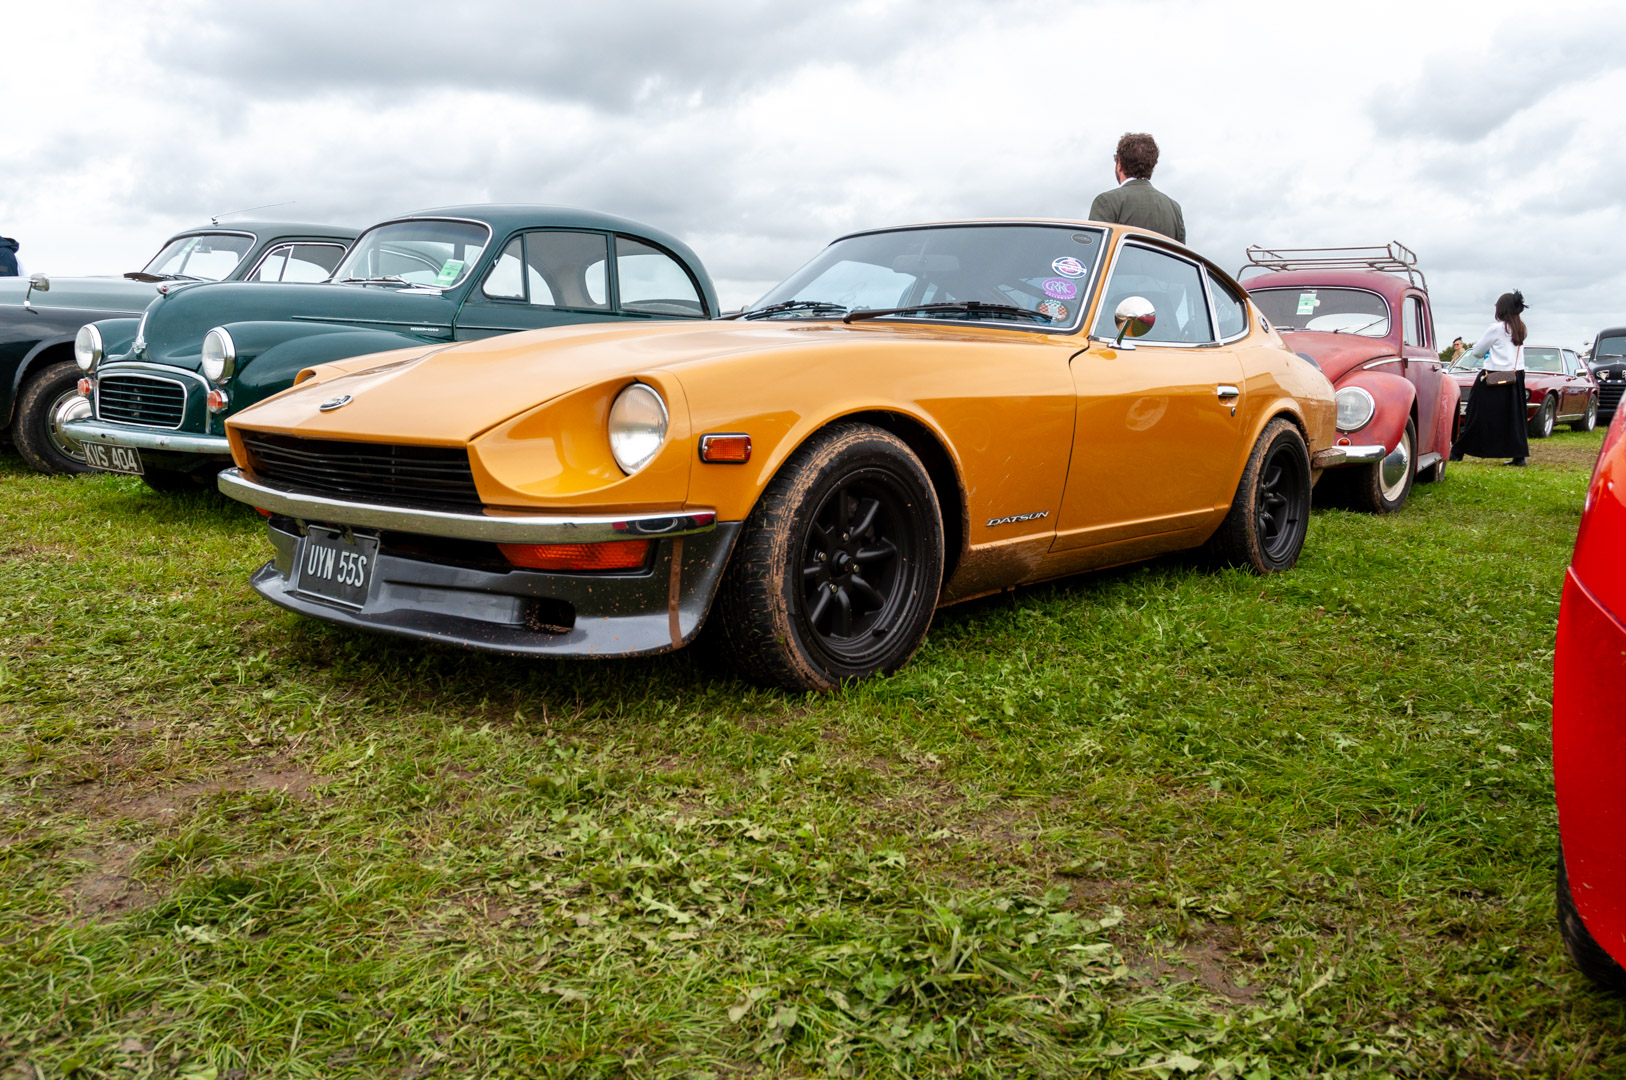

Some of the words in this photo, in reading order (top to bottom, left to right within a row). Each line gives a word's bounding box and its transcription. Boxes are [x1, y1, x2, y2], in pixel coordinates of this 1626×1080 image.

[83, 443, 109, 467] KVS
[112, 447, 138, 471] 404
[985, 510, 1049, 527] DATSUN
[307, 544, 336, 580] UYN
[337, 551, 368, 588] 55S
